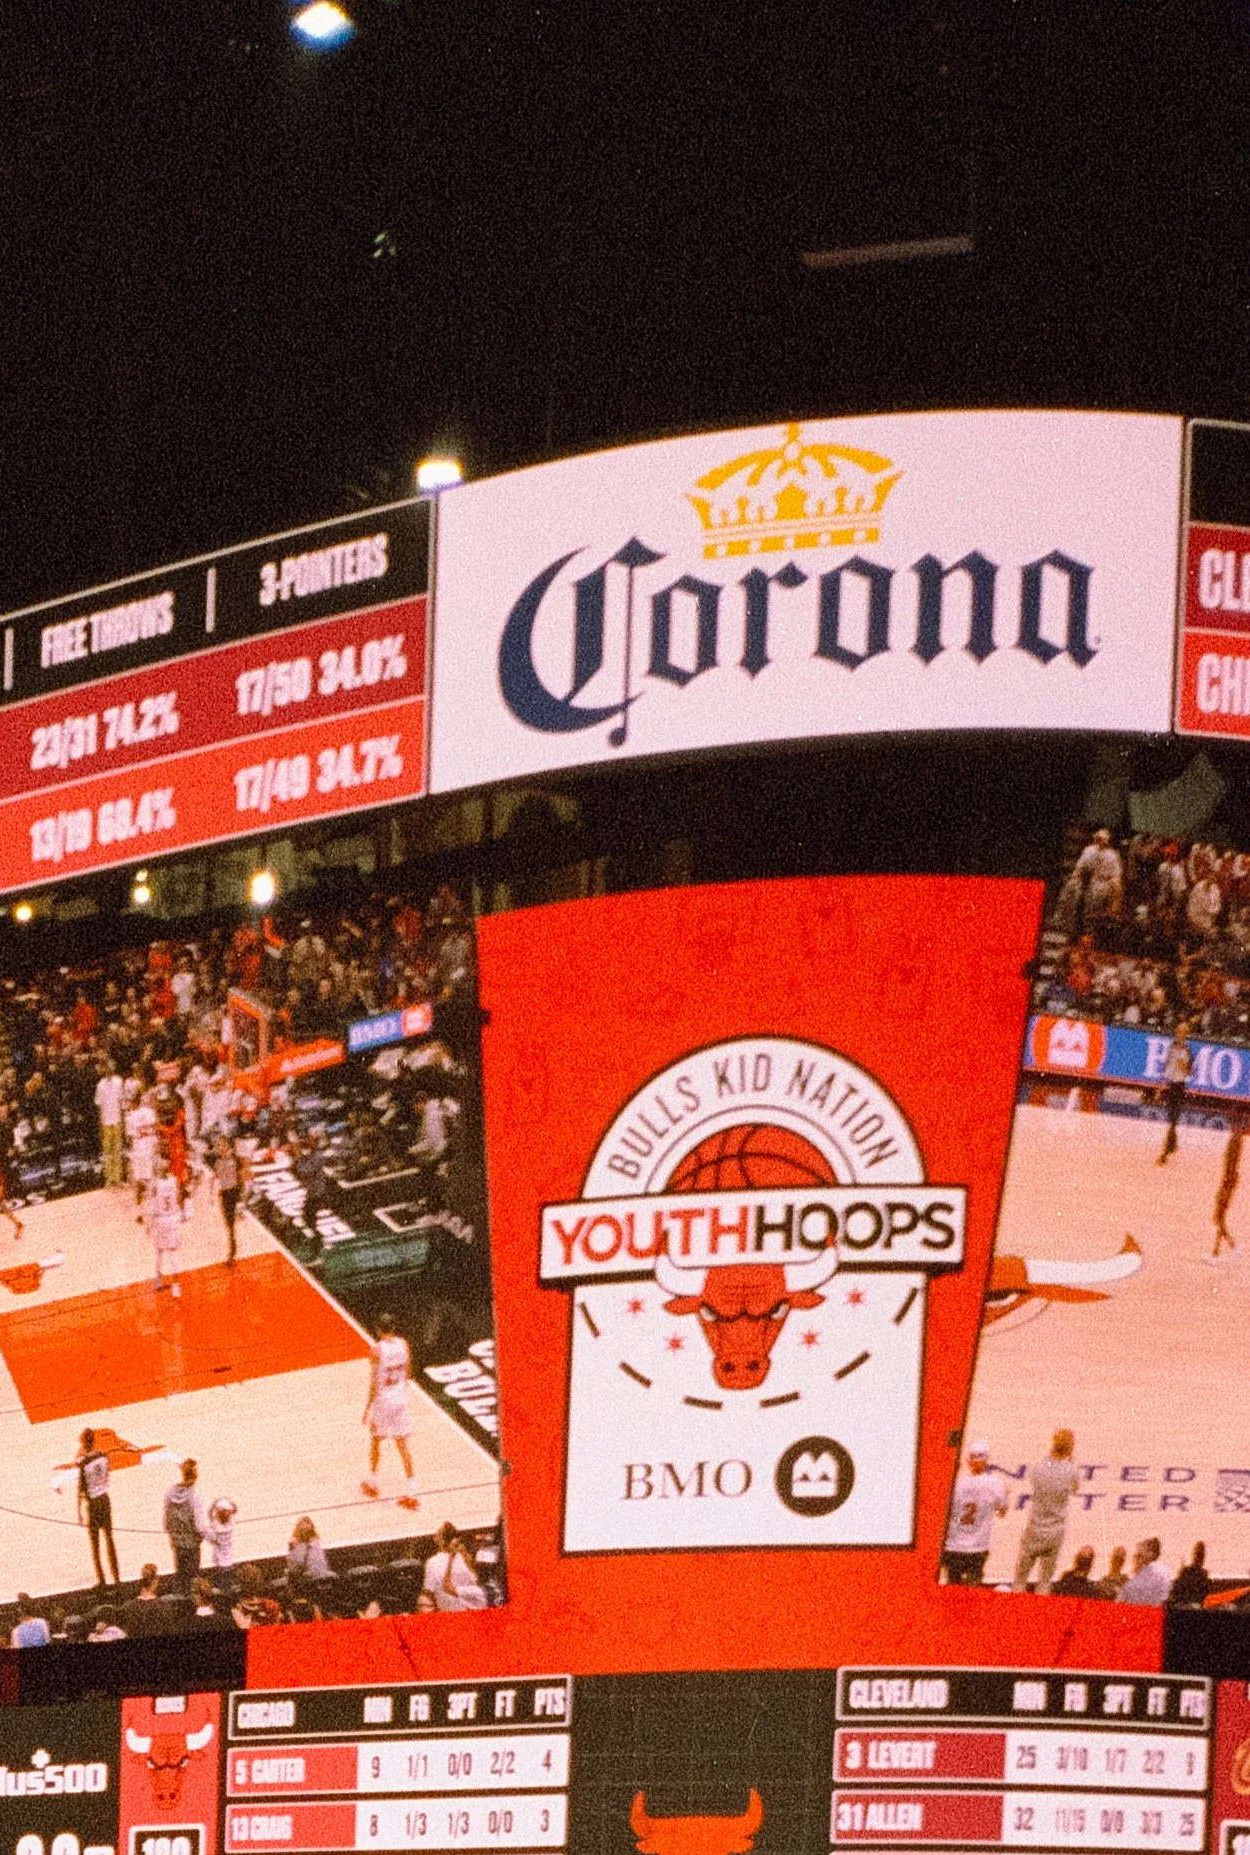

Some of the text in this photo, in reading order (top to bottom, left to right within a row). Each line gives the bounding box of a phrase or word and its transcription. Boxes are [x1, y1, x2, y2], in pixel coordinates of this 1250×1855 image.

[42, 618, 91, 667] FREE
[91, 591, 173, 652] THROWS
[259, 532, 387, 605] 3-POINTERS
[498, 537, 1099, 748] Corona
[104, 693, 178, 749] 74.2%
[237, 659, 310, 714] 17/50
[320, 636, 406, 694] 34.0%
[235, 756, 309, 811] 17/49
[318, 736, 402, 792] 34.7%
[607, 1053, 898, 1181] BULLS KID NATION
[552, 1202, 955, 1266] YOUTHHOOPS
[623, 1459, 753, 1501] BMO
[409, 1694, 430, 1721] FG
[447, 1692, 478, 1720] 3PT
[495, 1690, 515, 1717] FT
[534, 1687, 566, 1717] PTS
[850, 1680, 947, 1708] CLEVELAND
[234, 1750, 553, 1785] 5 CARTER 9 1/1 0/0 2/2 4
[845, 1741, 862, 1769] 3
[868, 1742, 936, 1769] LEVERT
[1016, 1745, 1037, 1770] 25
[230, 1808, 551, 1842] 13 CRAIG 8 1/3 1/3 0/0 3
[836, 1802, 864, 1832] 31
[866, 1804, 922, 1830] ALLEN
[1014, 1806, 1035, 1831] 32
